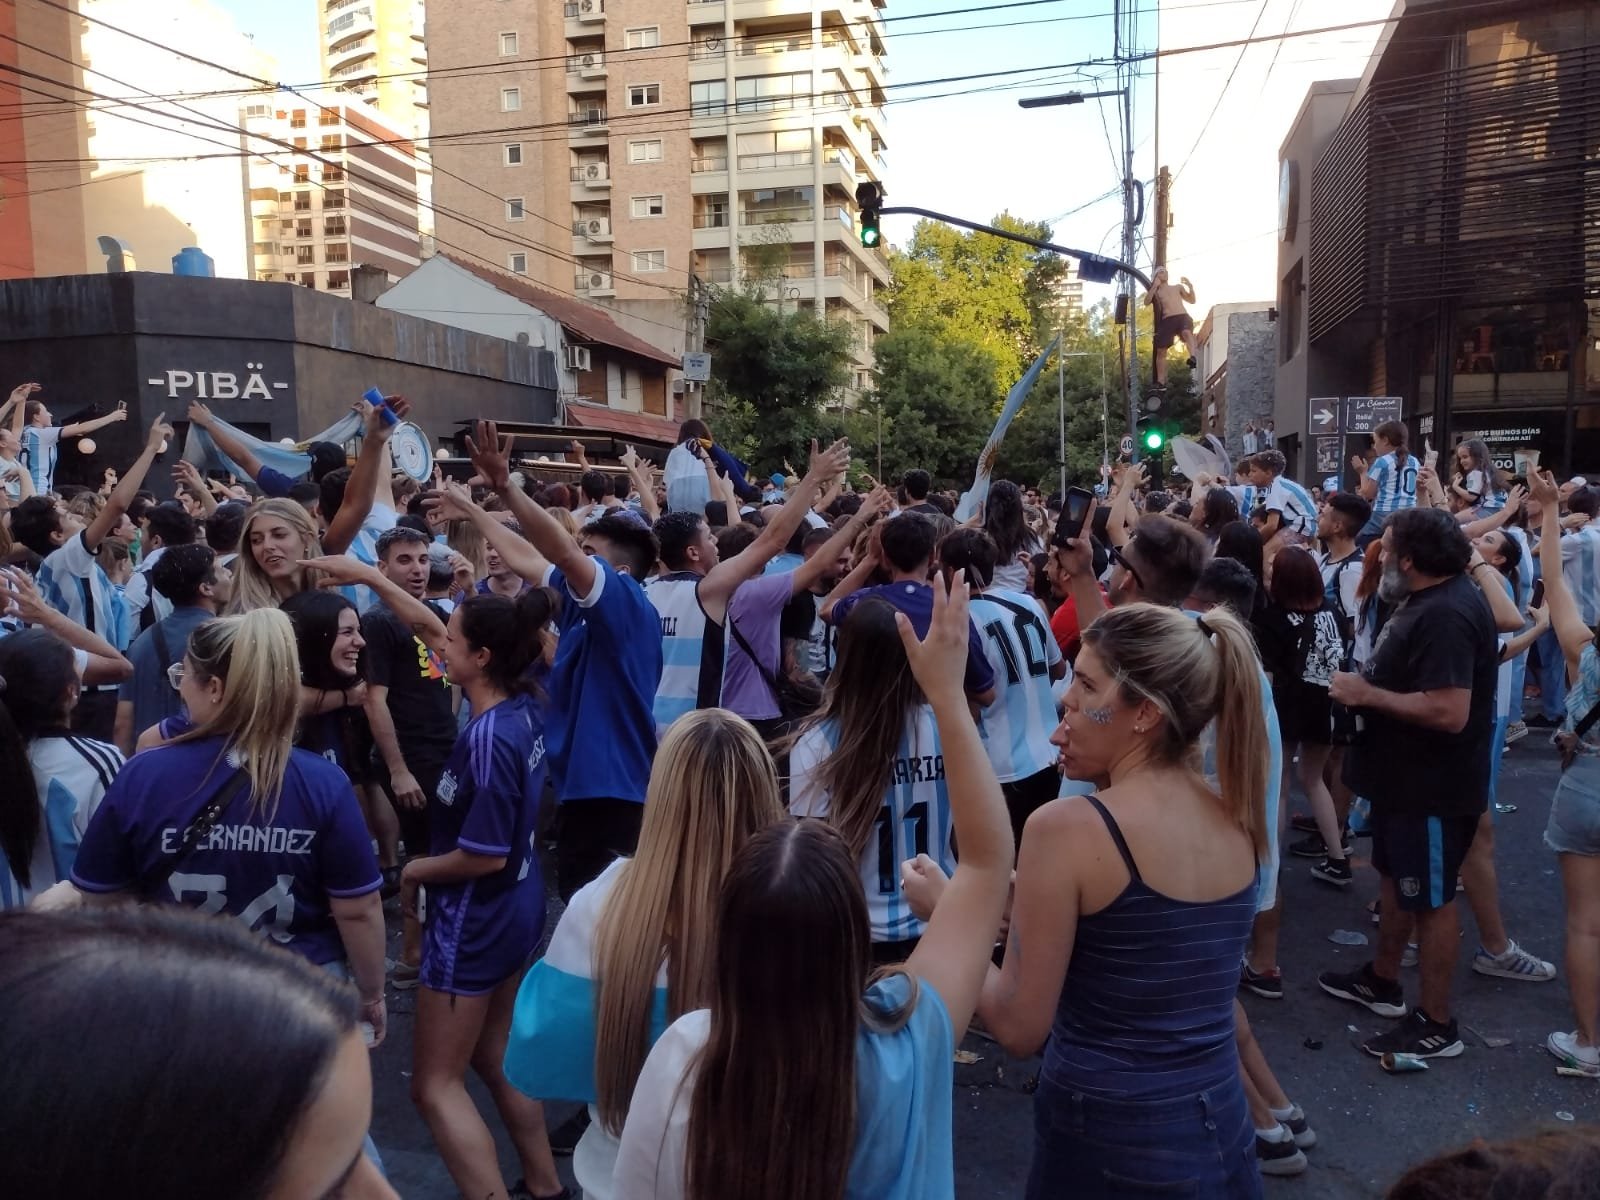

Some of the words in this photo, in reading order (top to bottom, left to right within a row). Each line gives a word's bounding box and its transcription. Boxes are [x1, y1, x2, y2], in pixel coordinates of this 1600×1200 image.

[1122, 439, 1134, 450] 40
[1522, 427, 1541, 435] DÍAS
[1395, 467, 1418, 496] 10
[983, 614, 1048, 685] 10
[891, 755, 946, 785] ARIA
[874, 801, 929, 893] 11
